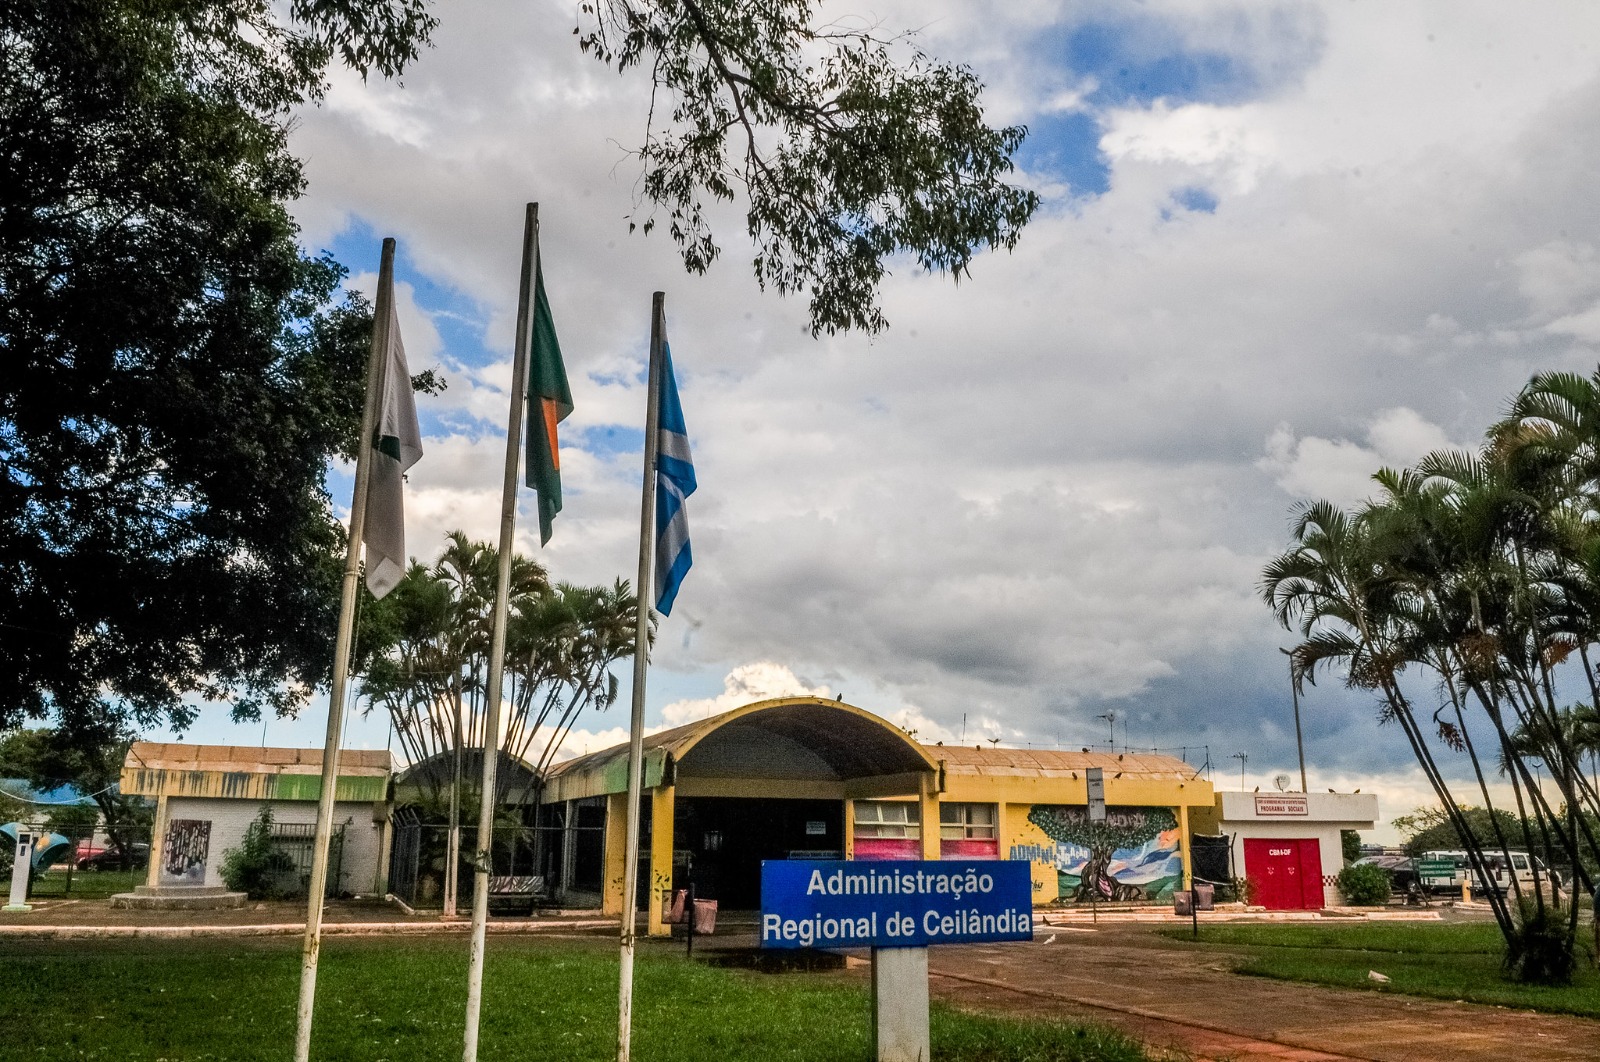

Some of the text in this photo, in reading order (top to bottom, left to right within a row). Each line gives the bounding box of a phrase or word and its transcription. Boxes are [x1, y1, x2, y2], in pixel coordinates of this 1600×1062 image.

[806, 868, 994, 900] Administração
[763, 908, 1031, 946] Regional de Ceilândia
